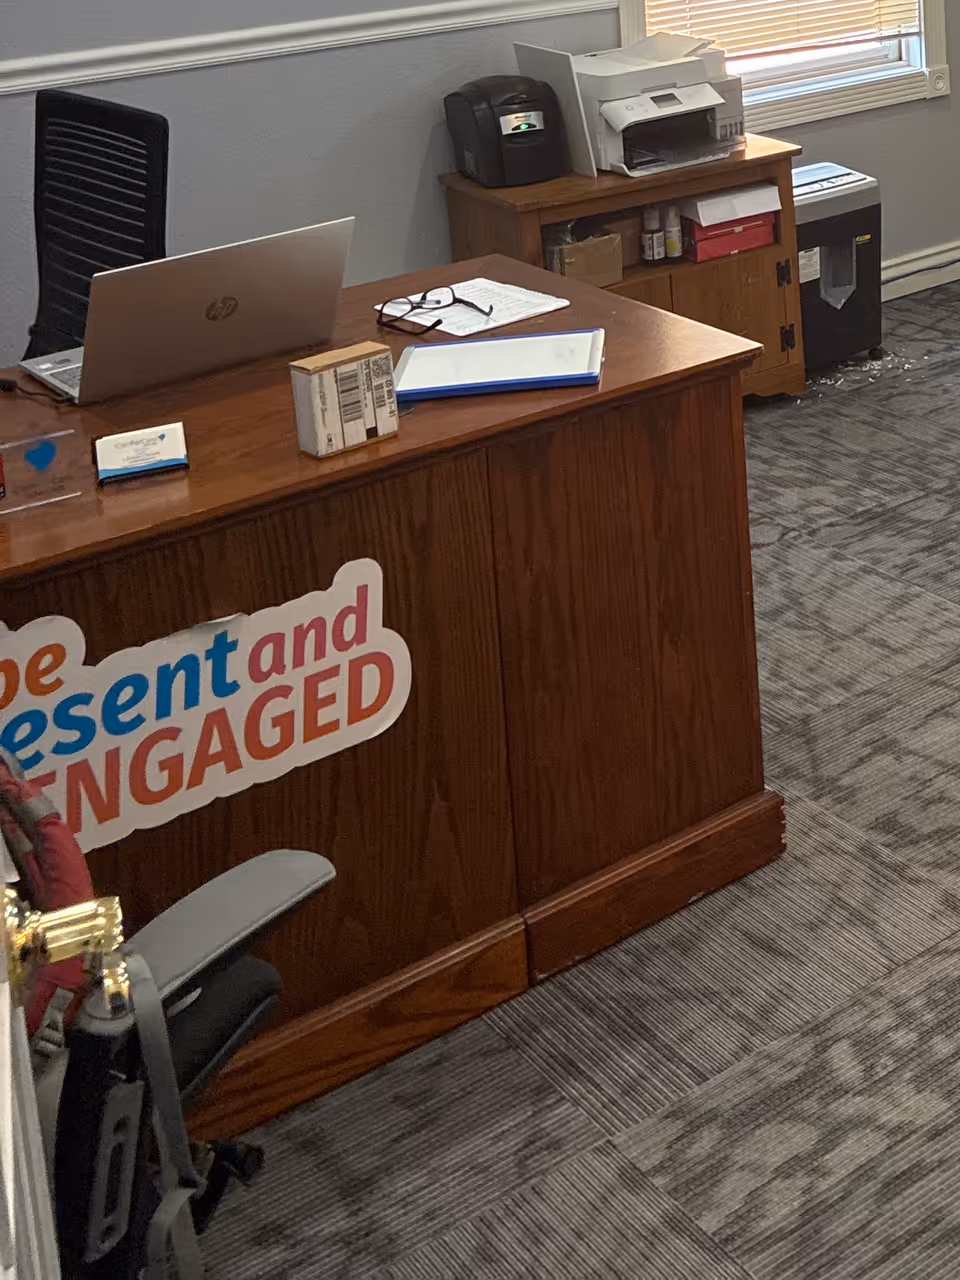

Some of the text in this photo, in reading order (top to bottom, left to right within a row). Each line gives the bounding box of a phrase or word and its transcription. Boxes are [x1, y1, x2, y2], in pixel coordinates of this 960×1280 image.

[206, 296, 238, 321] hp
[0, 584, 369, 772] esent and
[26, 651, 395, 835] NGAGED
